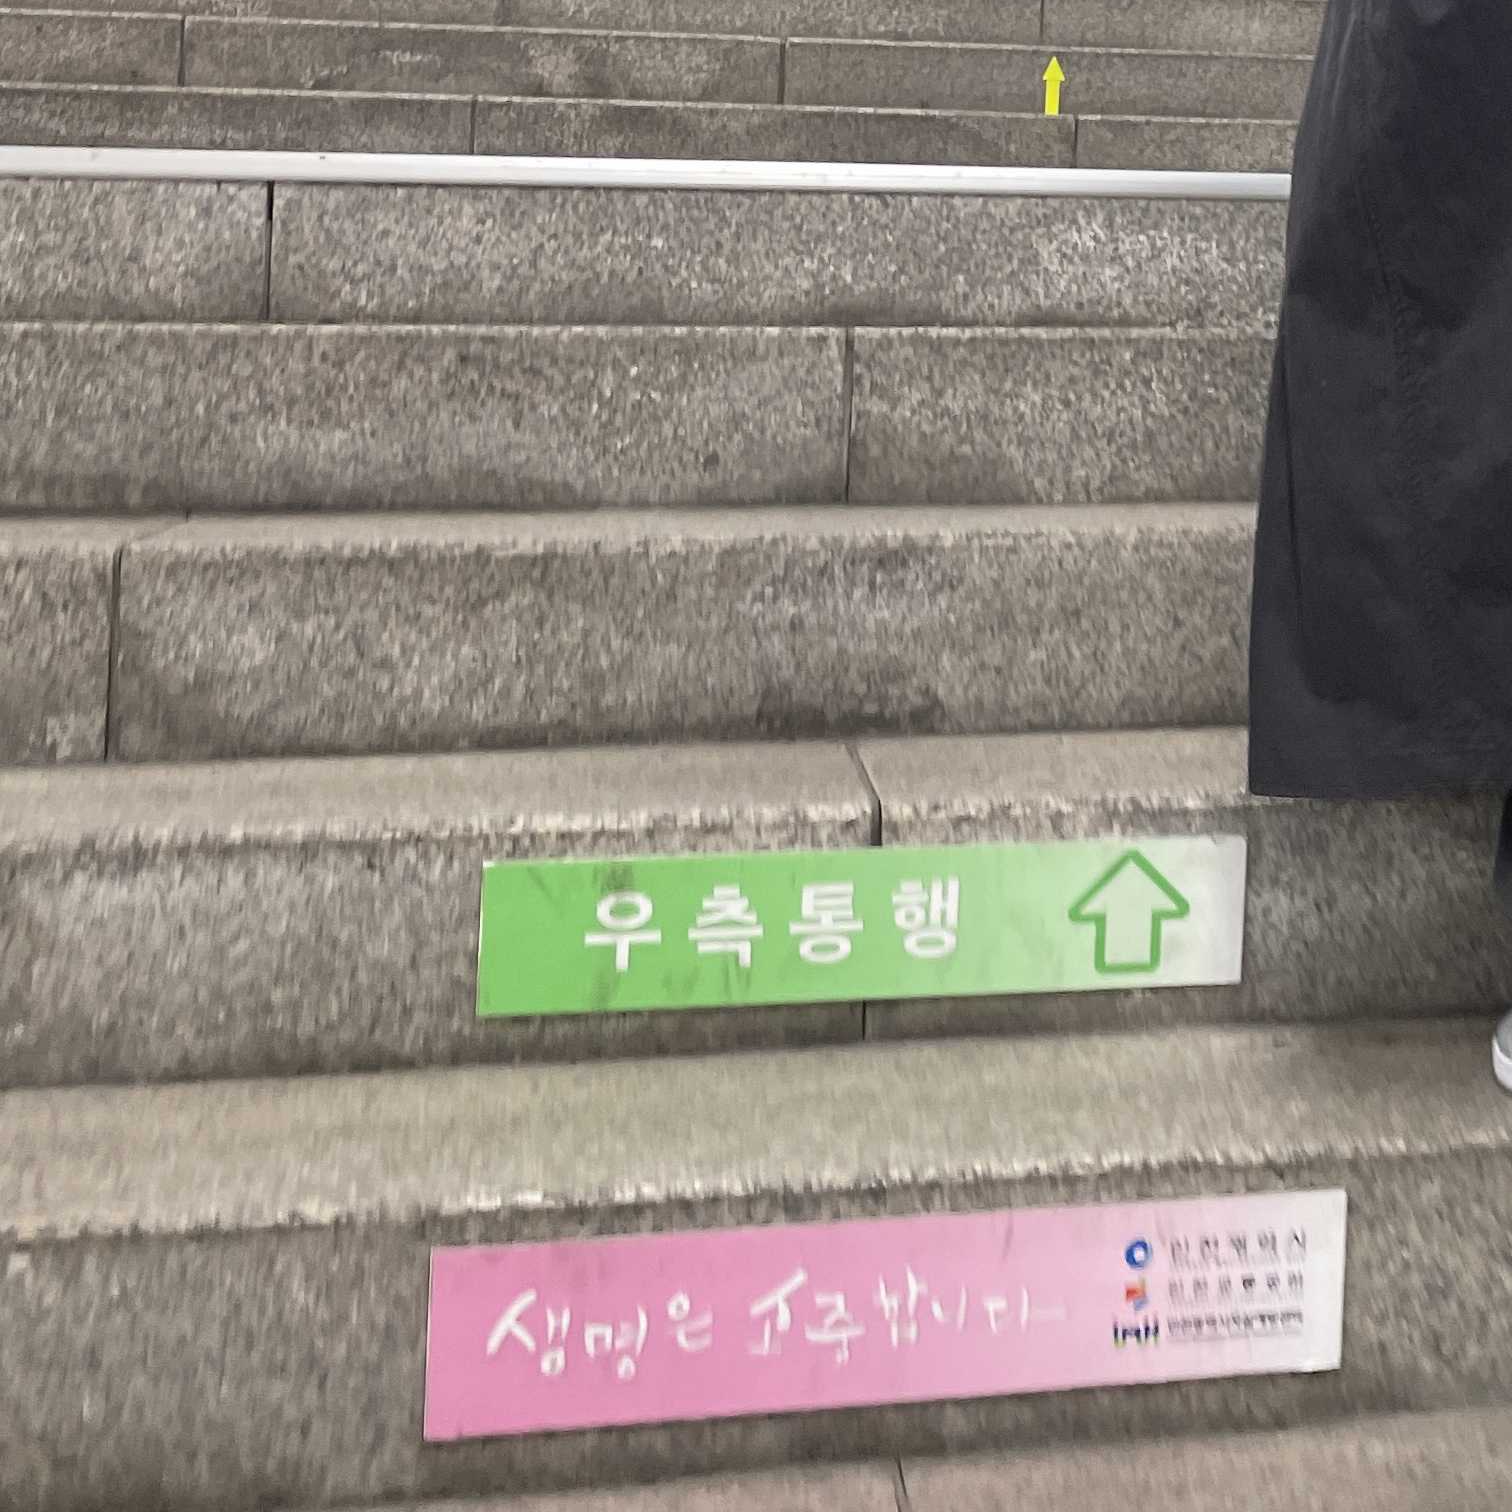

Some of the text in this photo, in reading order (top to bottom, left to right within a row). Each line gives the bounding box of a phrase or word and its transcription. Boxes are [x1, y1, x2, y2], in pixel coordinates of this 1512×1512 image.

[584, 875, 960, 972] 우측통행
[486, 1263, 1067, 1380] 생명은 소중합니다
